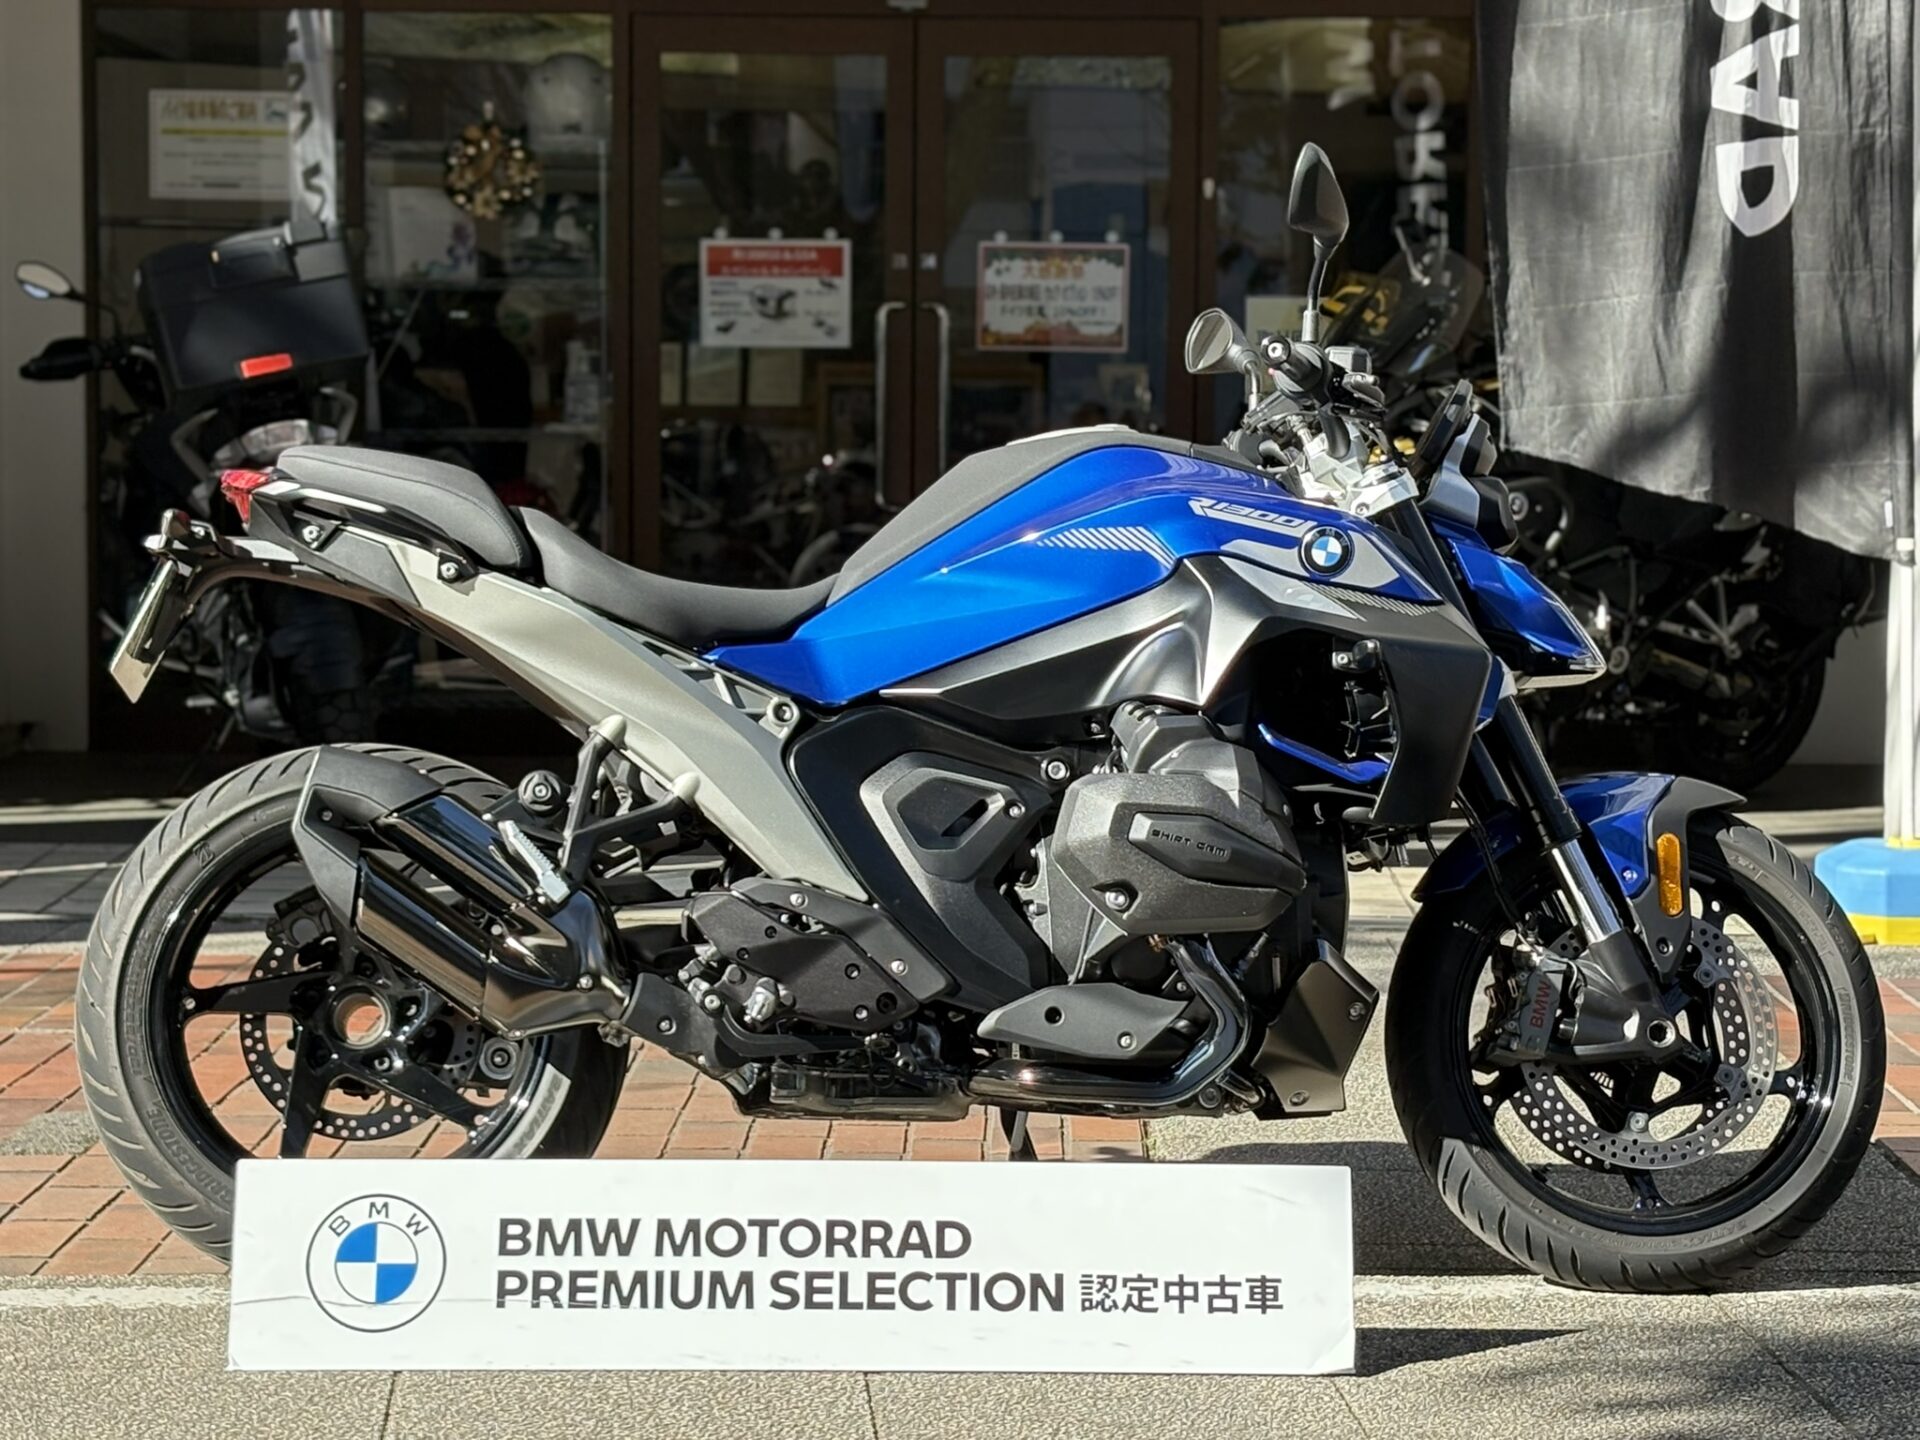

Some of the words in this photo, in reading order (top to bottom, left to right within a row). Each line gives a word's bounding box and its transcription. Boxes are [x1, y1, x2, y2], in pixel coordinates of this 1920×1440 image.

[1152, 829, 1192, 847] SHIFT
[1196, 841, 1227, 858] CAM
[1529, 980, 1552, 1028] BMW
[328, 1201, 429, 1237] BMW
[498, 1218, 641, 1256] BMW
[654, 1217, 972, 1259] MOTORRAD
[496, 1270, 755, 1310] PREMIUM
[769, 1270, 1064, 1312] SELECTION
[1079, 1273, 1283, 1314] 認定中古車
